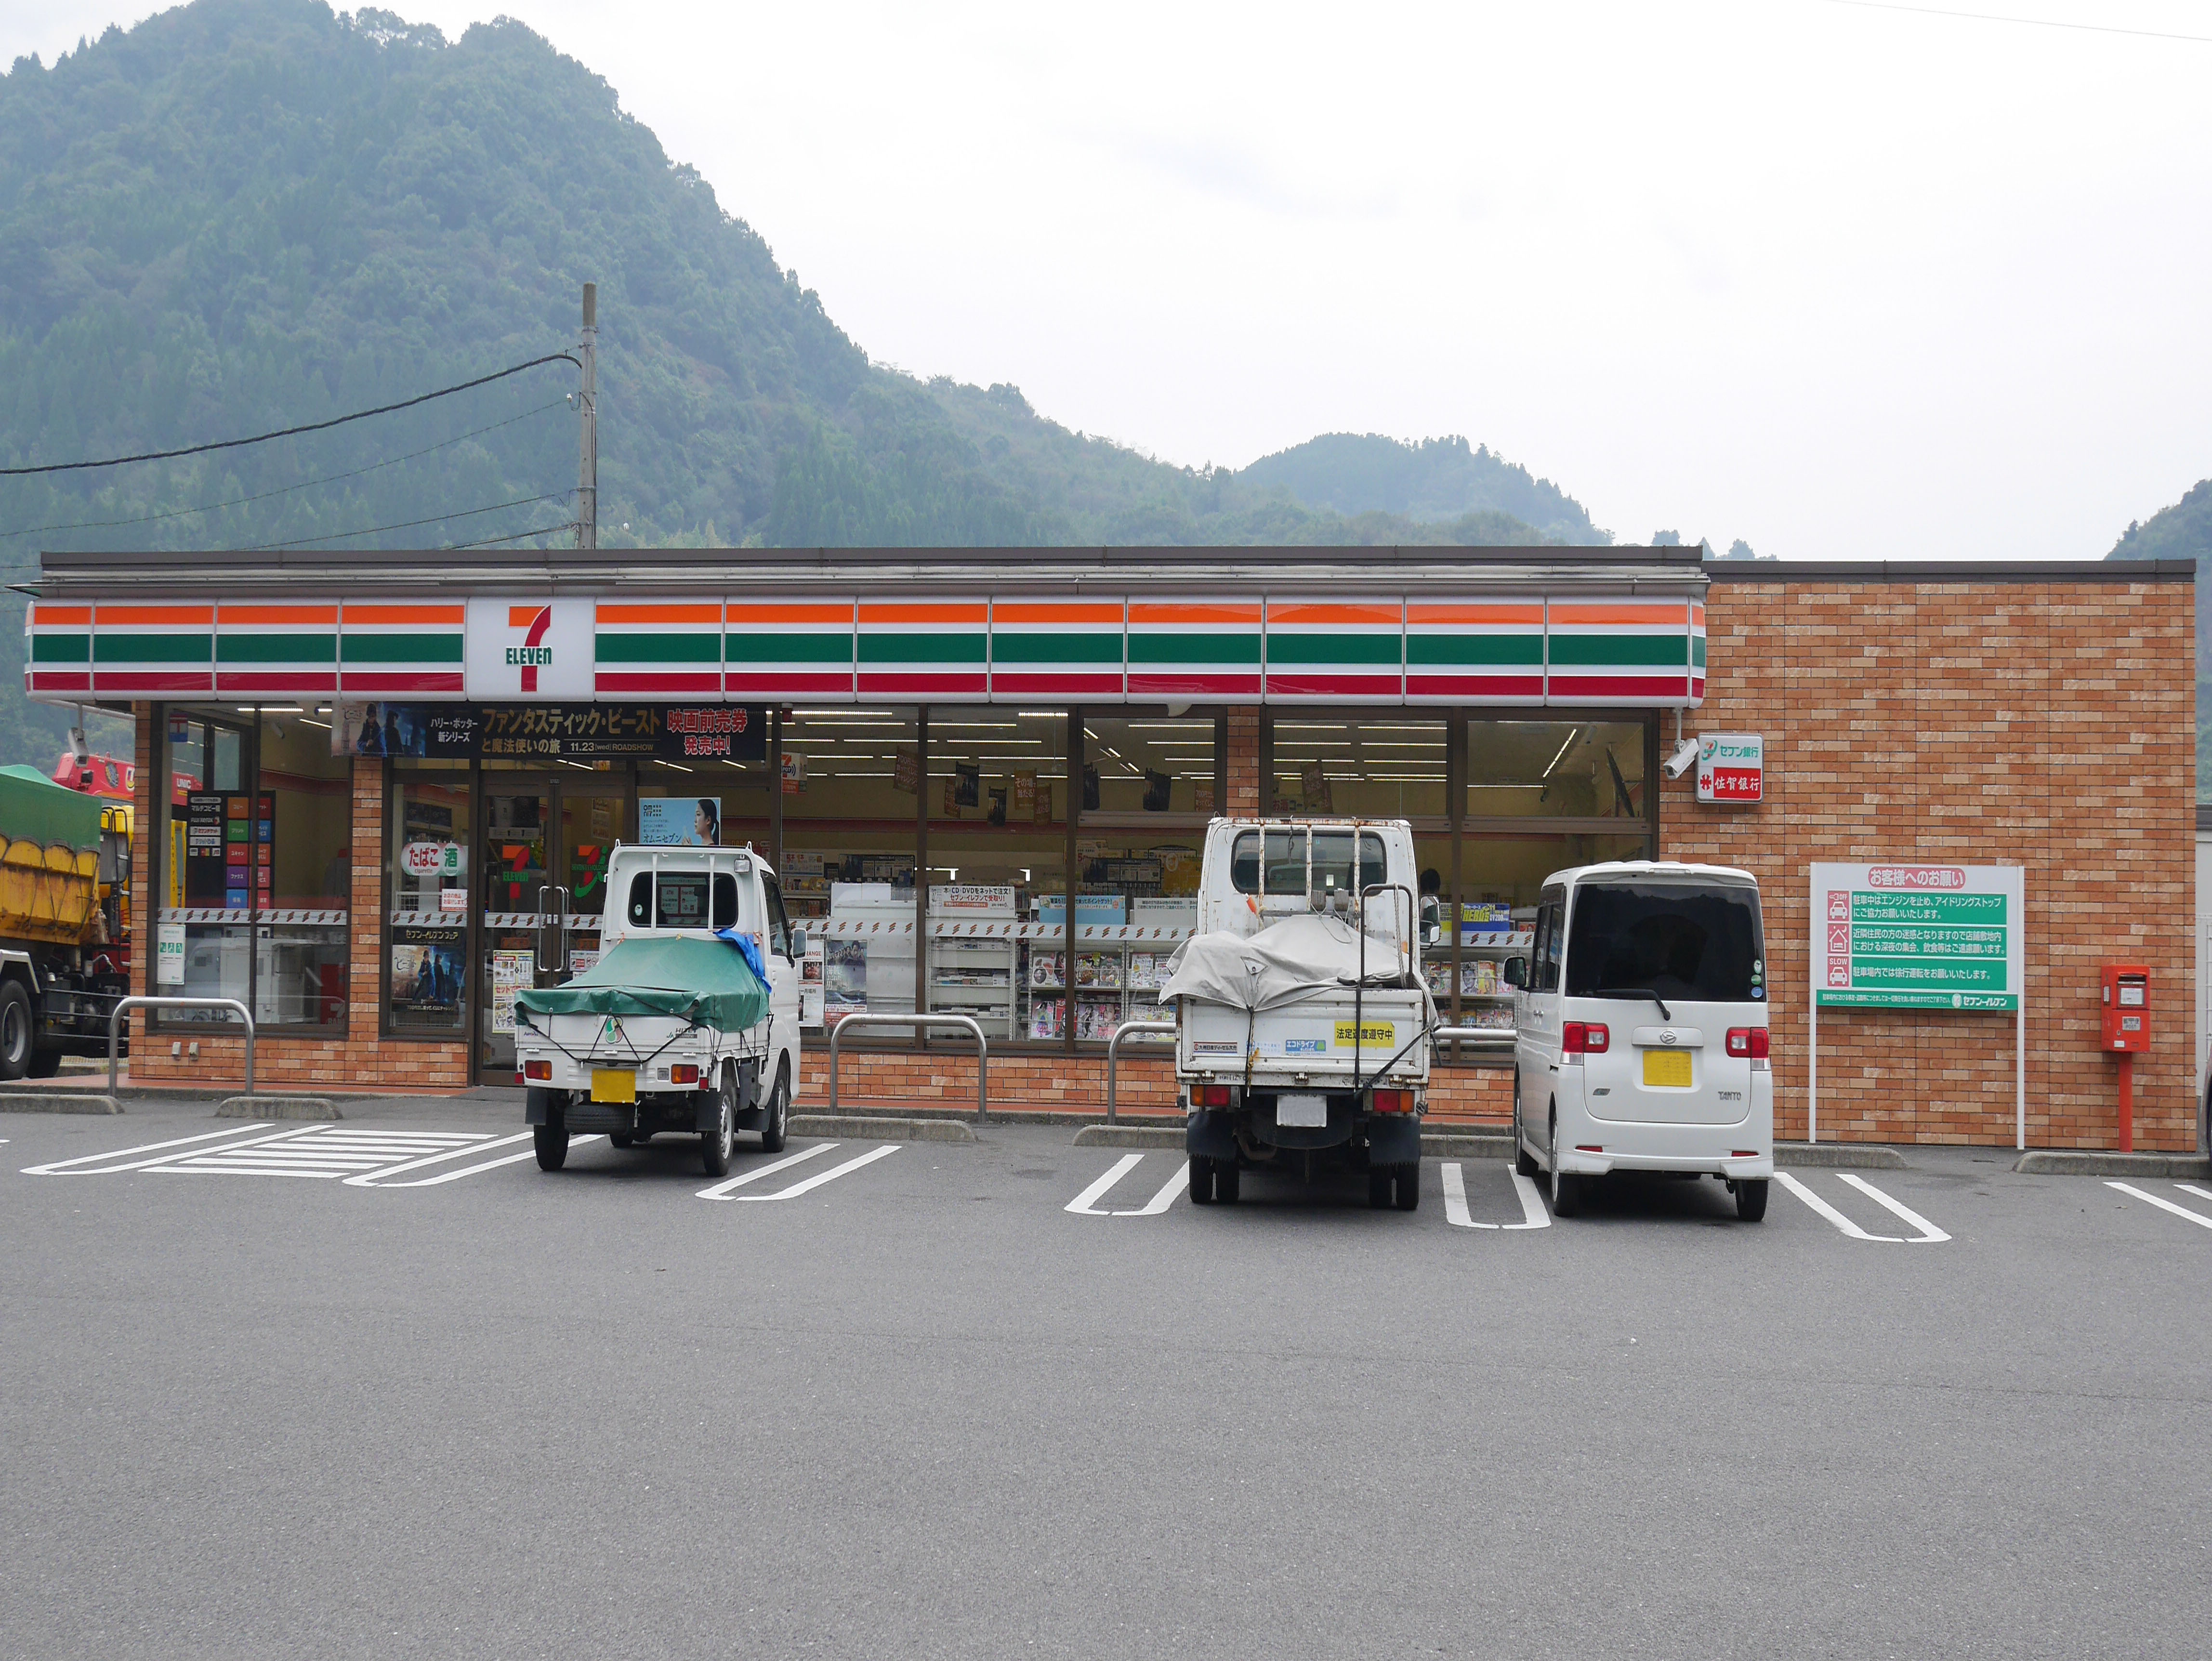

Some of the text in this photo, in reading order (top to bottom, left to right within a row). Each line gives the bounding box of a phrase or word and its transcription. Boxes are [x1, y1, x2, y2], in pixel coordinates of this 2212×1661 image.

[431, 717, 478, 729] ハリー・ポッター
[482, 708, 660, 736] ファンタスティック・ビースト
[667, 708, 748, 733] 映画前売券
[438, 731, 471, 742] 新シリーズ
[482, 738, 561, 754] と魔法使いの旅
[570, 742, 594, 751] 11.23
[684, 735, 730, 755] 発売中!
[1720, 746, 1758, 758] セブン銀行
[177, 778, 191, 789] UNIC
[1715, 777, 1760, 791] 佐賀銀行
[644, 833, 682, 843] オムニセブン
[409, 847, 439, 867] たばこ
[444, 848, 458, 867] 酒
[1870, 869, 1963, 887] お客様へのお願い
[1718, 1091, 1741, 1101] TANTO
